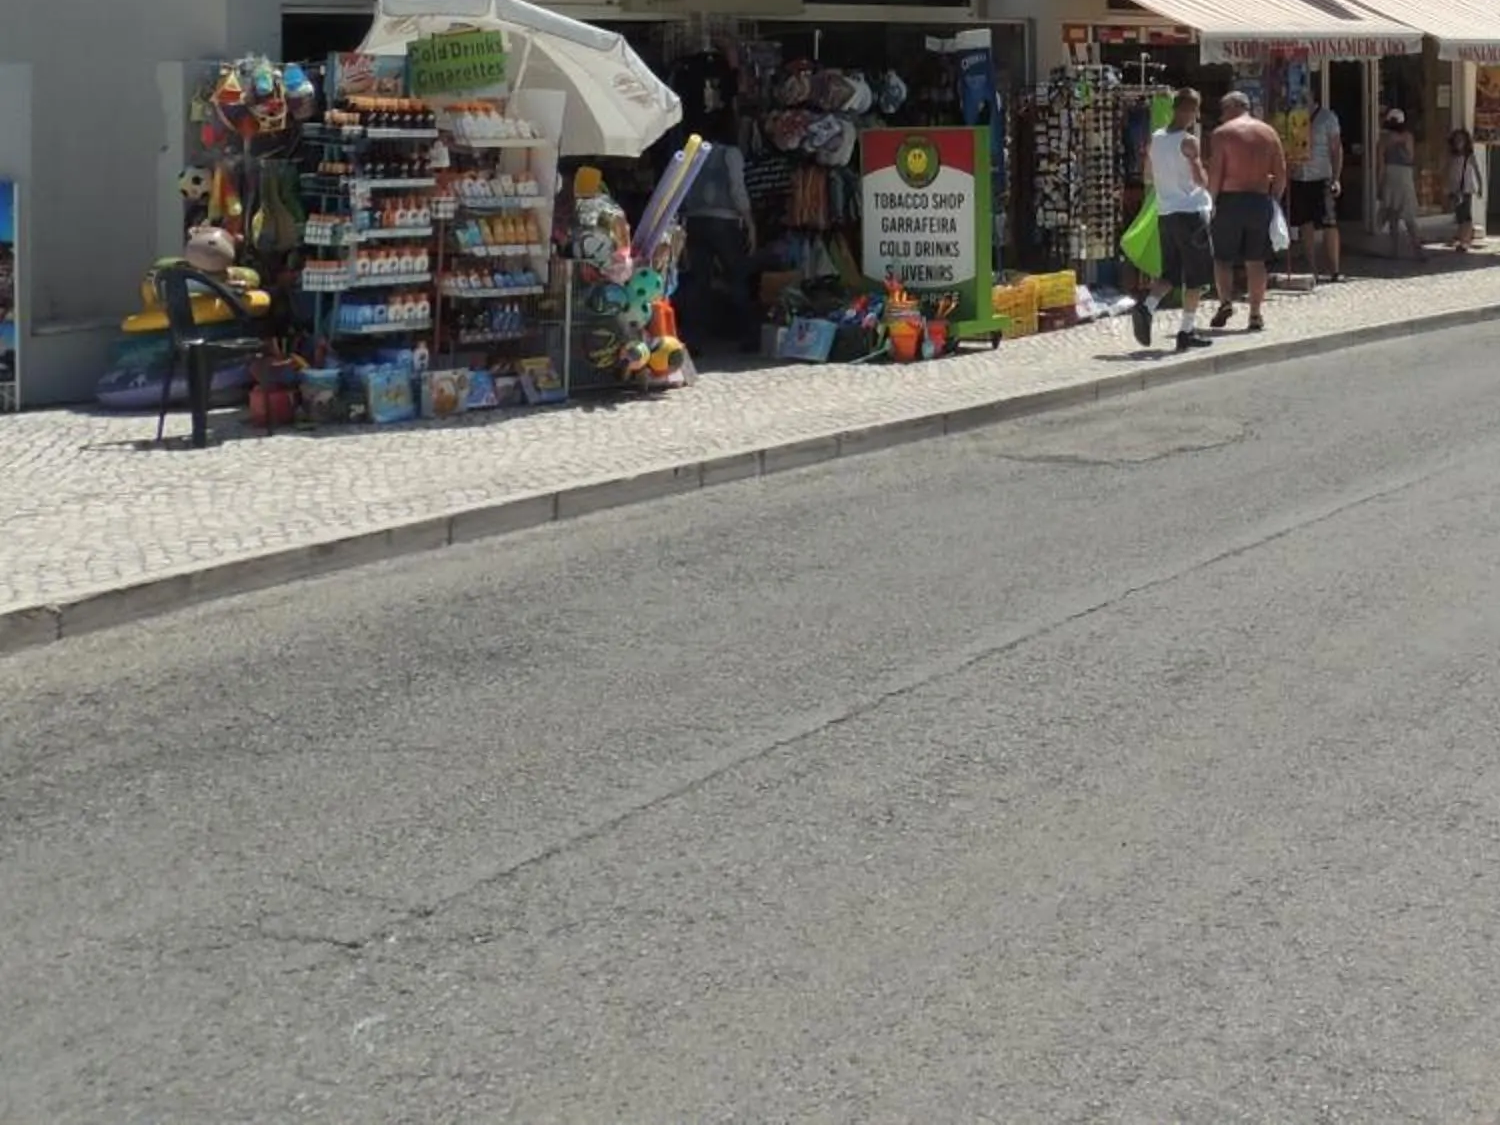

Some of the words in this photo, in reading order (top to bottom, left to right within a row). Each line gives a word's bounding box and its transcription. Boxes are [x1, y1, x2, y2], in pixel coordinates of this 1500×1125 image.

[409, 36, 448, 66] Cold
[450, 35, 503, 59] Drinks
[417, 62, 504, 89] Cigarettes
[874, 193, 929, 210] TOBACCO
[931, 193, 966, 209] SHOP
[881, 217, 958, 235] GARRAFEIRA
[879, 241, 911, 258] COLD
[915, 241, 961, 258] DRINKS
[885, 264, 955, 283] SUVENIRS
